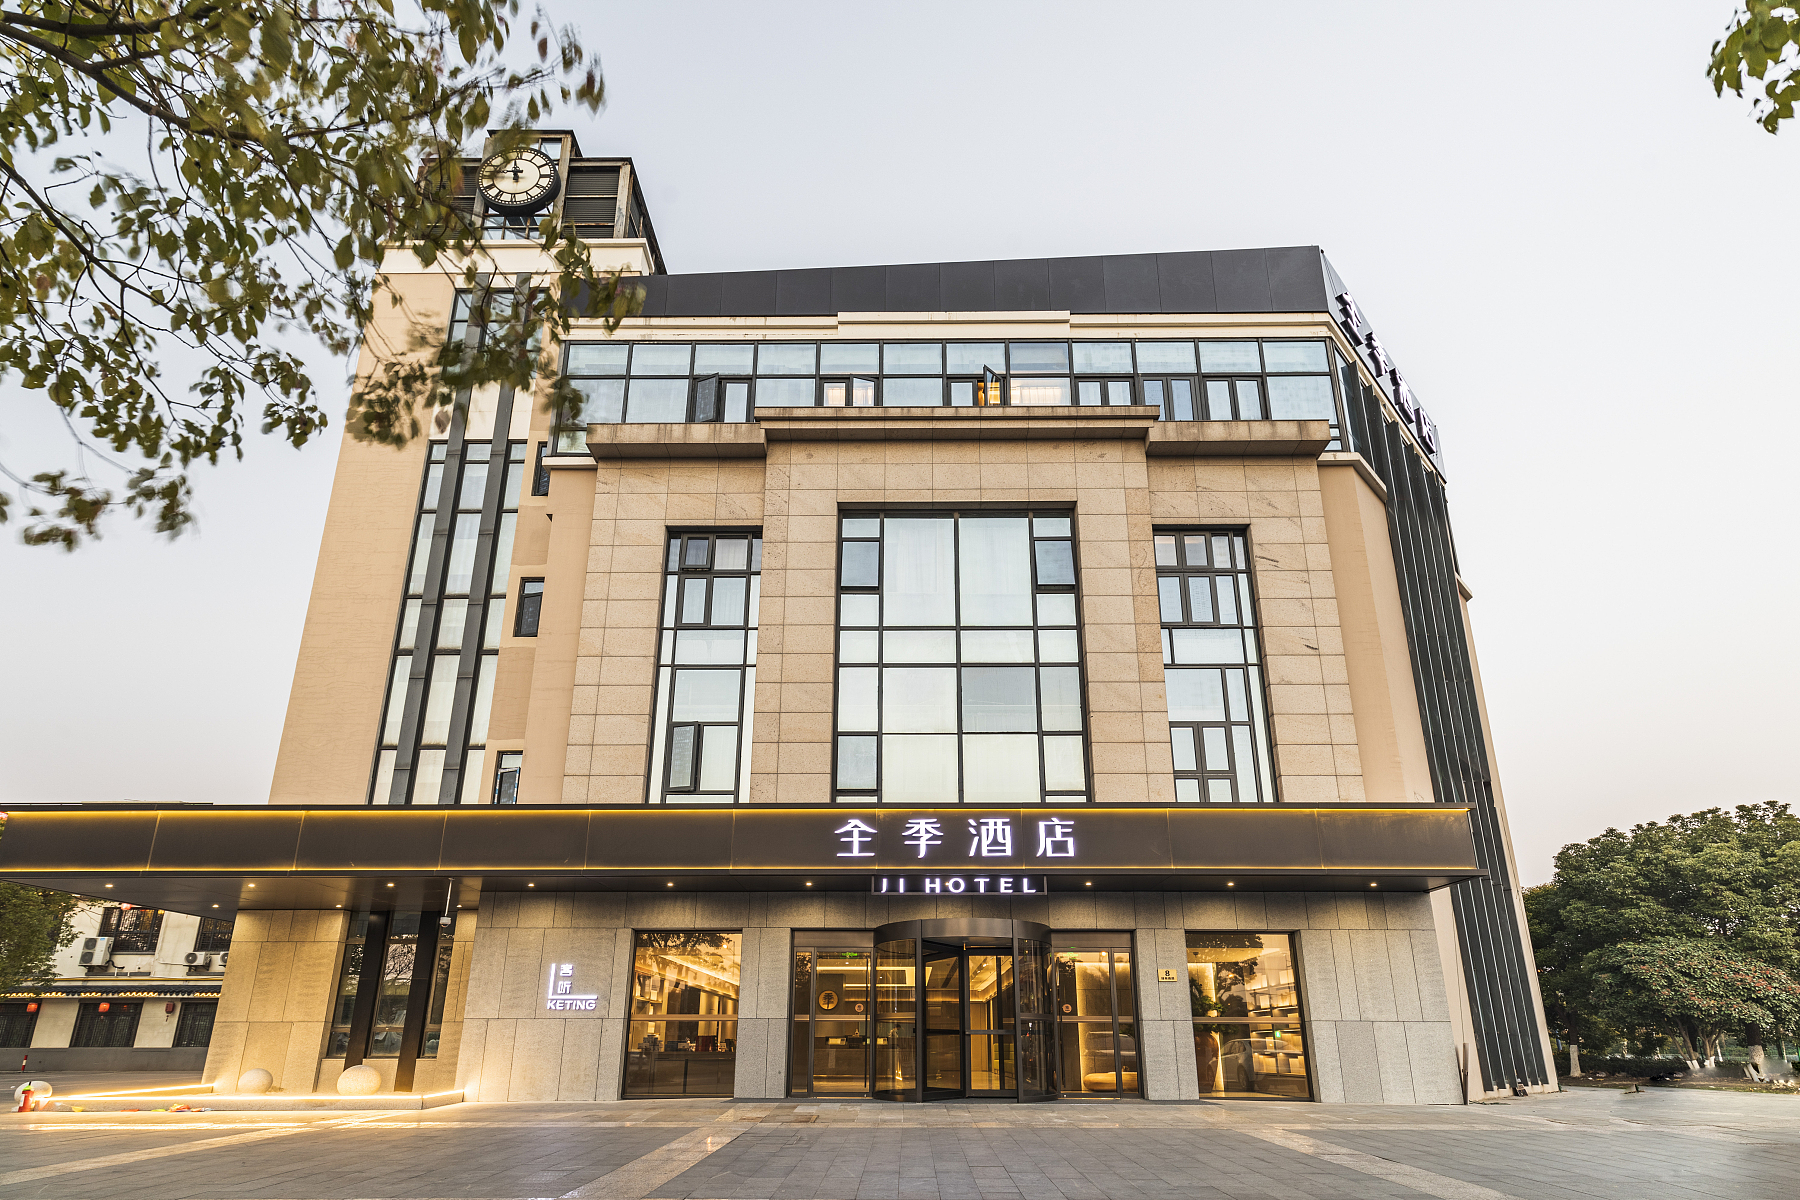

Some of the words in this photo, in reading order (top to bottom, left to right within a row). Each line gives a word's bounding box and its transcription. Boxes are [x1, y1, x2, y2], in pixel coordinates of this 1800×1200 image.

[834, 817, 1075, 858] 全季酒店
[880, 878, 904, 893] JI
[925, 878, 1036, 893] HOTEL
[547, 1000, 596, 1010] KETING
